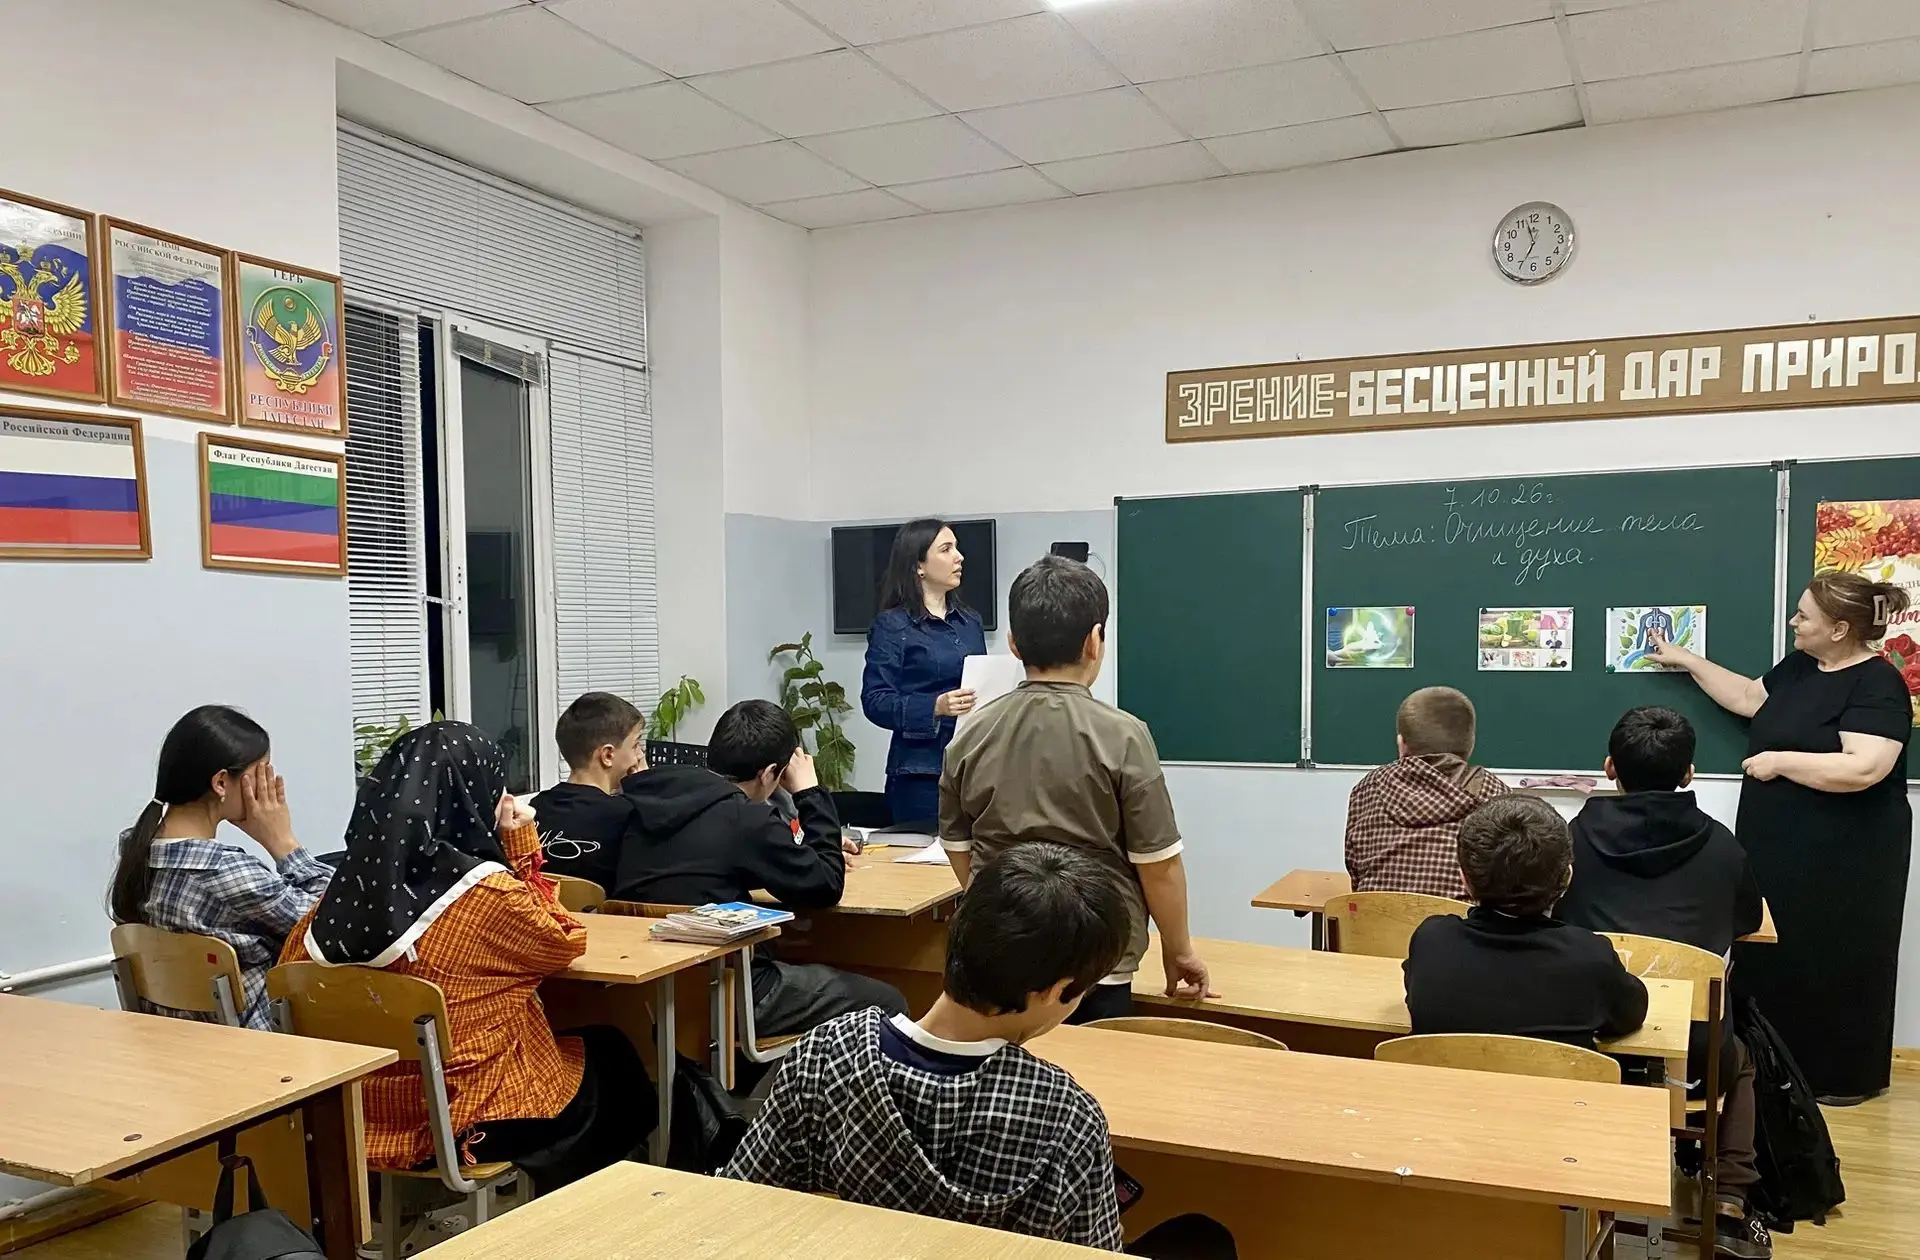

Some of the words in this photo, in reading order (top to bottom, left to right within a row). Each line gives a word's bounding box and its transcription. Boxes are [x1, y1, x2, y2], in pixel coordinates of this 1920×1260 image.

[1529, 213, 1540, 223] 12
[1547, 216, 1552, 224] 1
[1516, 219, 1525, 229] 11
[1554, 224, 1561, 233] 2
[1507, 229, 1518, 239] 10
[1557, 234, 1564, 244] 3
[1504, 242, 1511, 251] 9
[1553, 246, 1560, 255] 4
[114, 239, 172, 260] РОССИЙСКОЙ
[173, 254, 219, 272] ФЕДЕРАЦИИ
[1507, 253, 1514, 262] 8
[1518, 260, 1525, 270] 7
[1545, 256, 1552, 266] 5
[1530, 262, 1537, 272] 6
[1619, 345, 1722, 401] ДАР
[1741, 333, 1920, 393] ПРИРО
[250, 393, 333, 416] РЕСПУБЛИКИ
[3, 420, 69, 436] Российской
[72, 427, 130, 441] Федерации
[213, 449, 236, 461] Флаг
[240, 453, 292, 468] Республики
[294, 460, 333, 474] Дагестан
[1342, 513, 1435, 550] Тема:
[1445, 512, 1604, 548] Очищение
[1621, 512, 1705, 532] тела
[1492, 551, 1507, 565] и
